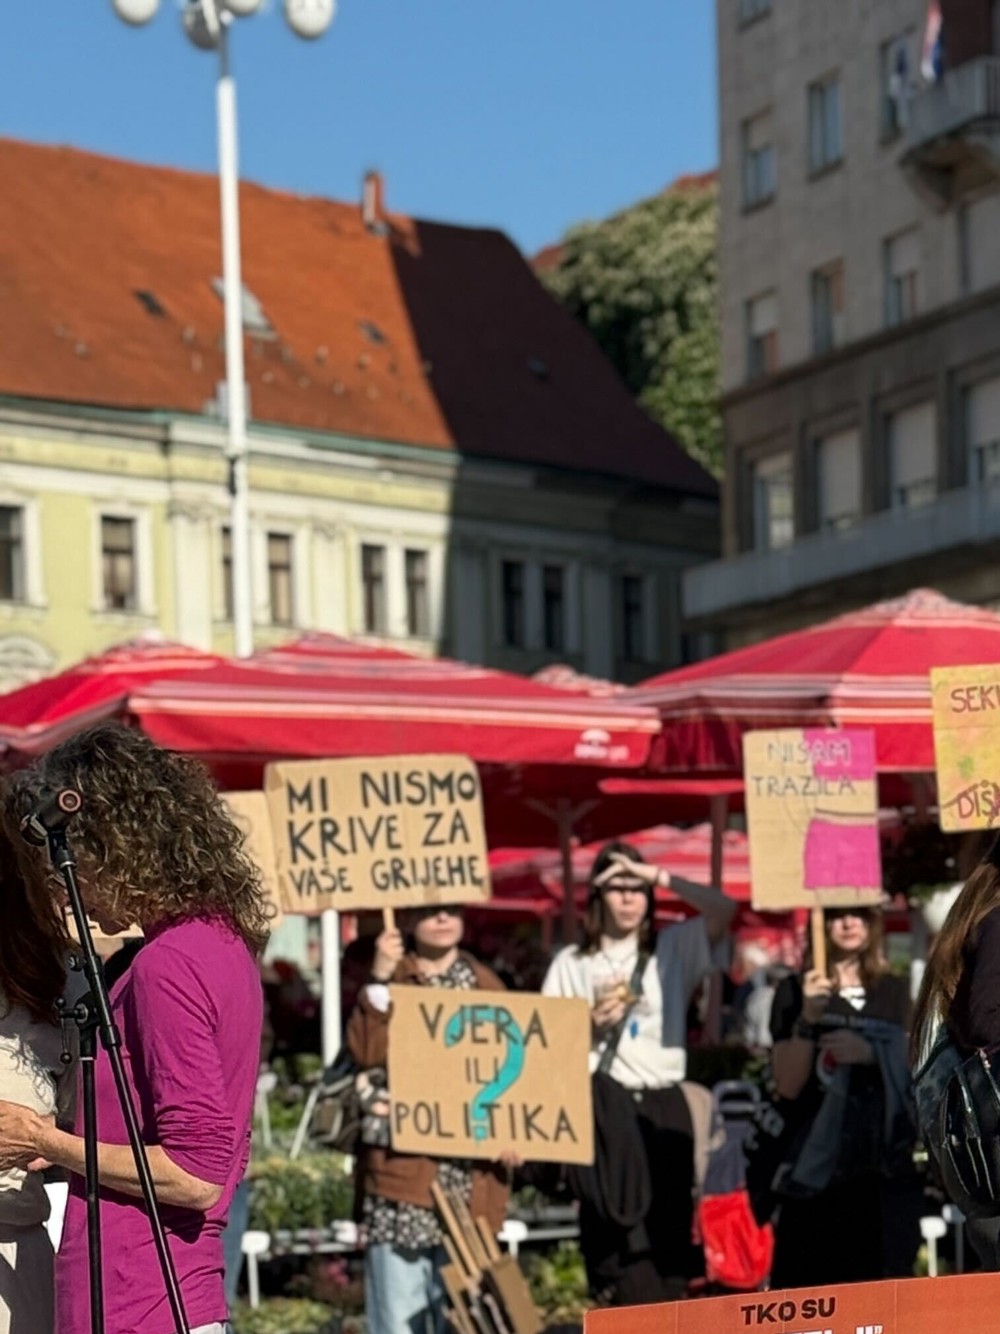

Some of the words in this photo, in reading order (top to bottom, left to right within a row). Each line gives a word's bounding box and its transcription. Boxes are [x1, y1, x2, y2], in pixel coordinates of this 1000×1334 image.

[287, 777, 328, 814] MI
[361, 770, 477, 808] NISMO
[288, 815, 402, 864] KRIVE
[422, 810, 470, 847] ZA
[289, 857, 352, 897] VAŠE
[371, 855, 484, 891] GRIJEHE
[419, 1003, 548, 1048] VJERA
[466, 1057, 499, 1084] ILI
[395, 1101, 578, 1143] POLITIKA
[741, 1300, 796, 1325] TKO
[802, 1297, 836, 1319] SU
